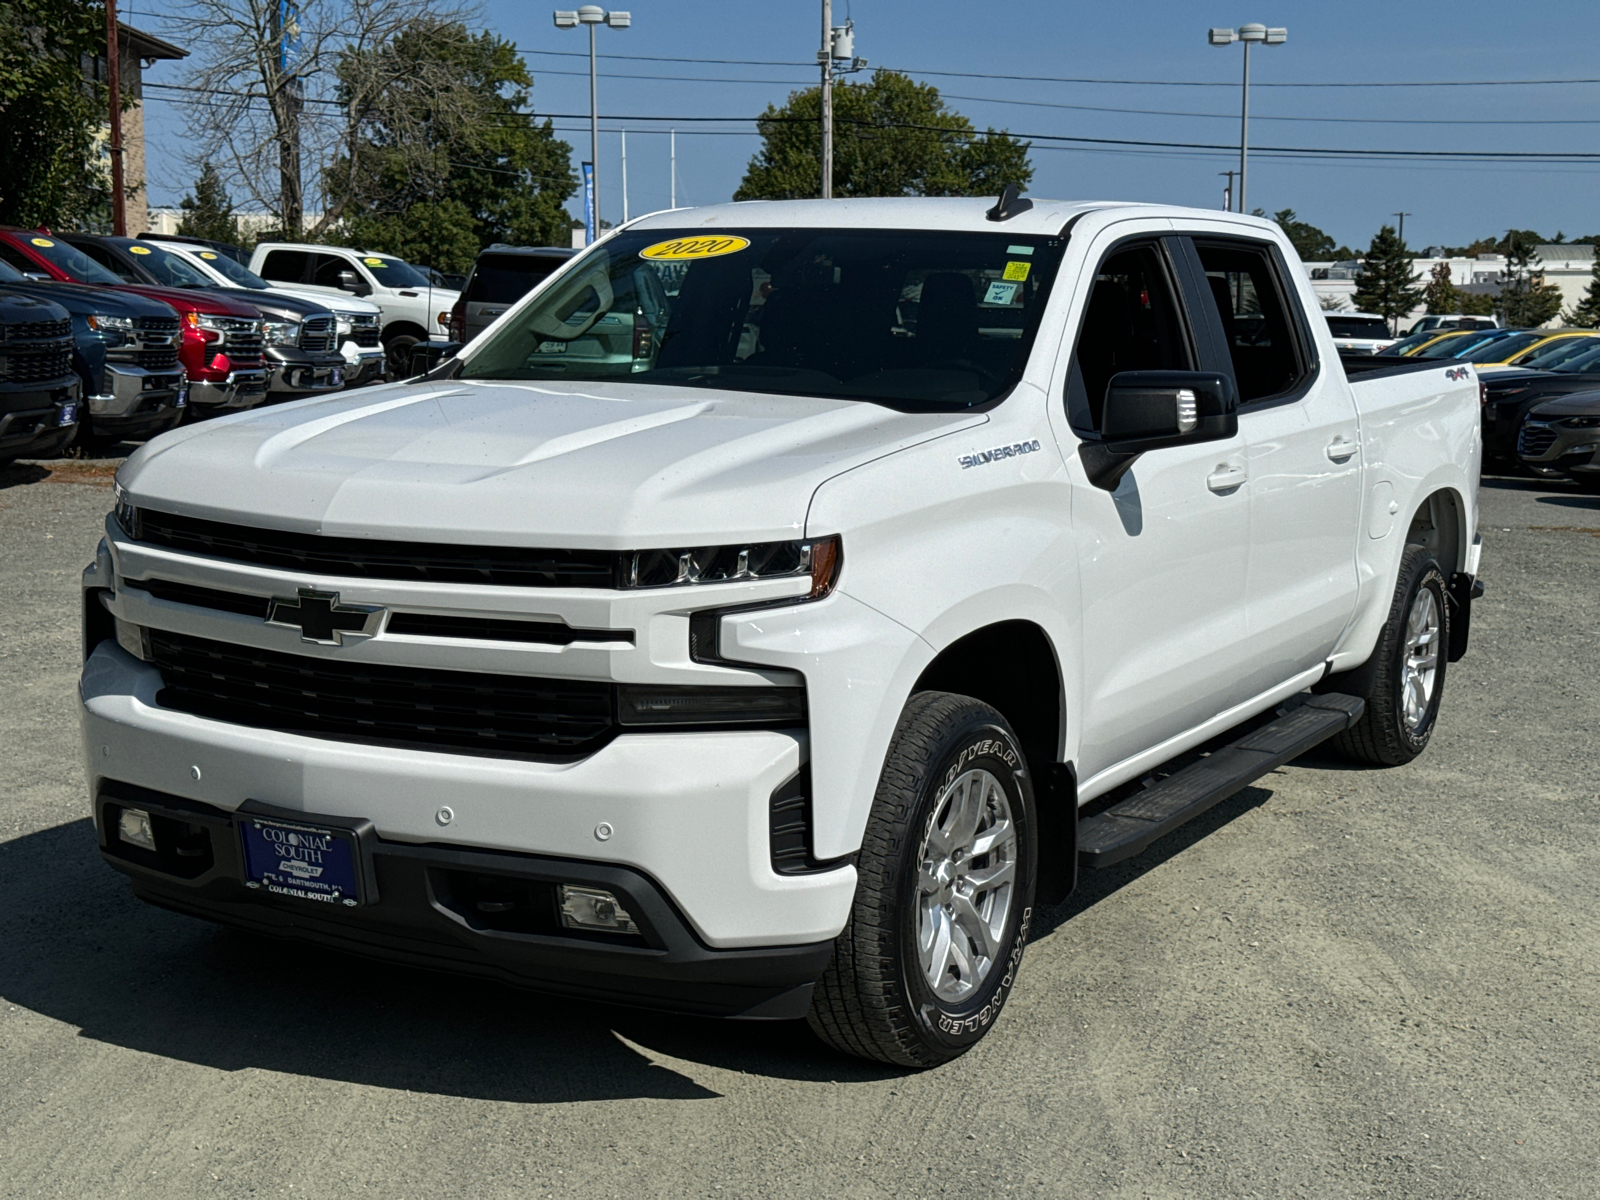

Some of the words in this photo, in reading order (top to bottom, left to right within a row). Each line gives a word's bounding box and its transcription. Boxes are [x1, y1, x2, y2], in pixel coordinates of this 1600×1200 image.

[652, 239, 735, 256] 2020
[957, 438, 1042, 470] SILVERADO
[274, 843, 323, 864] SOUTH
[282, 862, 319, 875] CHEVROLET
[268, 884, 307, 898] COLONIAL
[287, 877, 331, 892] DARTMOUTH,
[937, 907, 1032, 1035] WRANGLER
